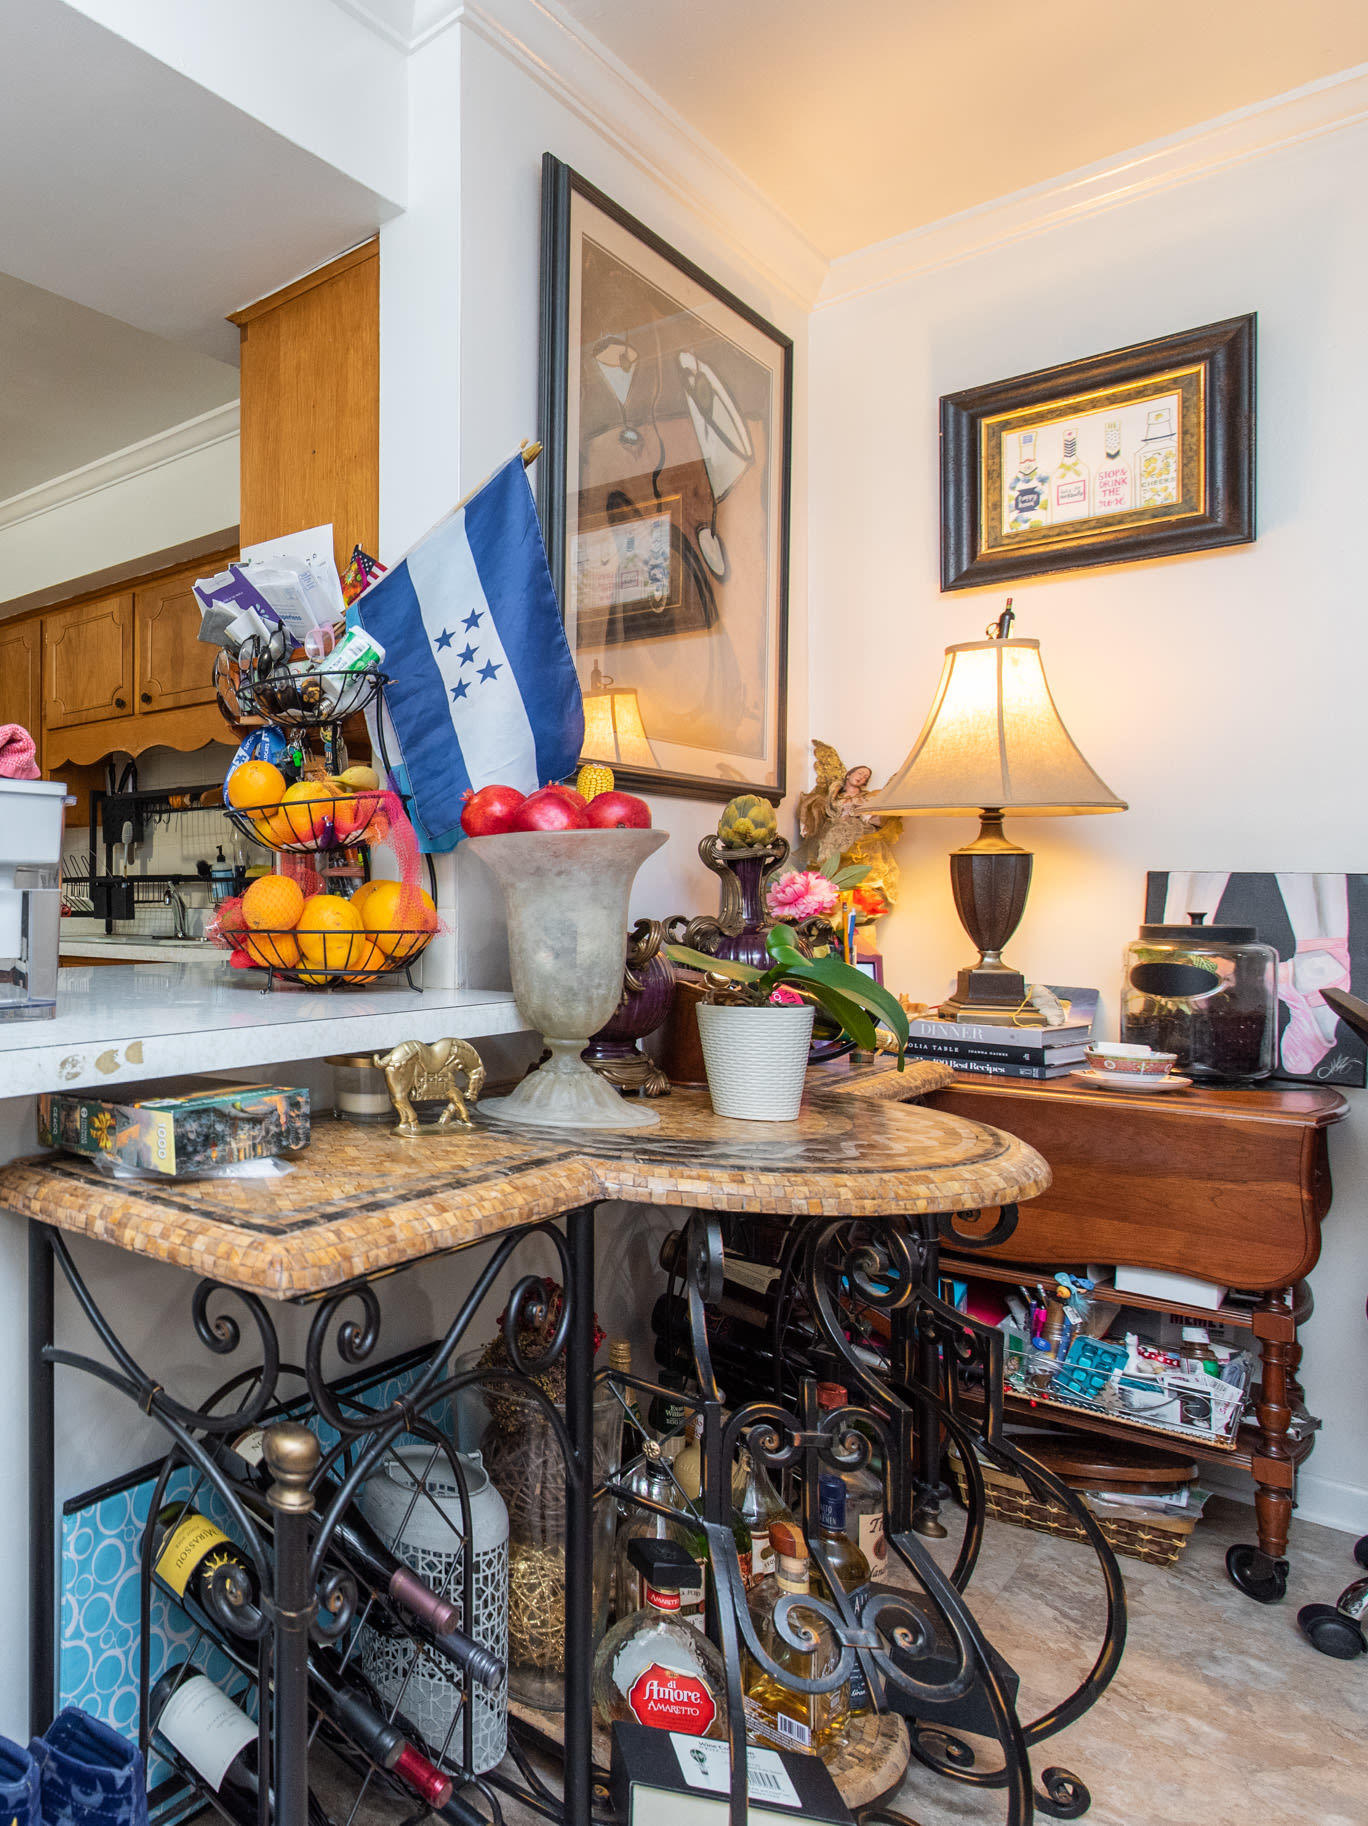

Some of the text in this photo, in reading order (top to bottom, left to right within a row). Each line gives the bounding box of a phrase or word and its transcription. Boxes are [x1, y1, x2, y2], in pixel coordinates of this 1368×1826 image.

[1102, 487, 1121, 497] THE
[920, 1023, 984, 1040] DINNER
[908, 1042, 929, 1050] OLIA
[933, 1044, 959, 1053] TABLE
[950, 1060, 968, 1070] Best
[969, 1061, 1006, 1075] Recipes
[156, 1122, 167, 1160] 1000
[175, 1527, 218, 1569] MIRASSOU
[667, 1680, 677, 1689] di
[648, 1700, 700, 1717] AMARETTO
